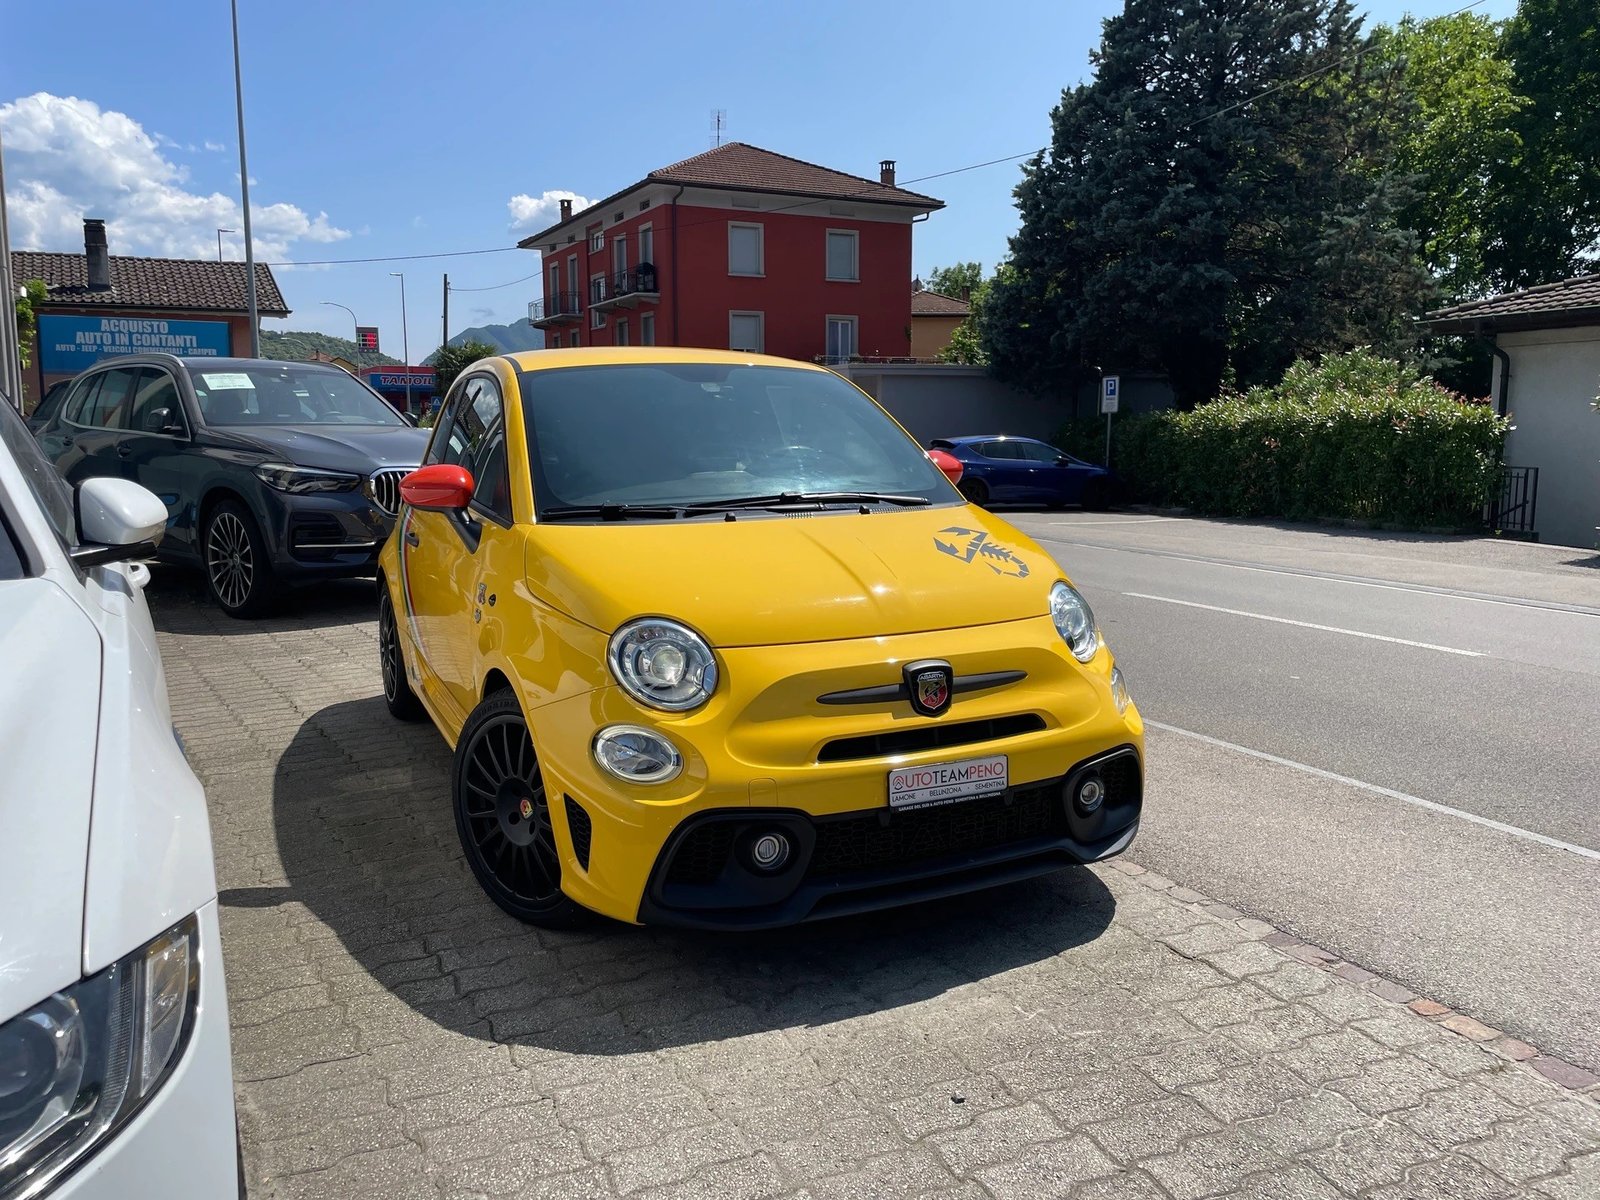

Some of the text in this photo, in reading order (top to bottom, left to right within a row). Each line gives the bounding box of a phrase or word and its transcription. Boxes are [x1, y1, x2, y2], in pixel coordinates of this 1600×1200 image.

[101, 319, 169, 334] ACQUISTO
[76, 332, 197, 348] AUTO IN CONTANTI
[103, 345, 132, 354] VEICOLI
[133, 346, 183, 355] COMMERCIALI
[189, 348, 217, 356] CAMPER
[381, 376, 433, 385] TAMOIL
[1107, 380, 1115, 395] P
[892, 780, 1005, 802] LAMONE BELLINZONA SEMENTINA
